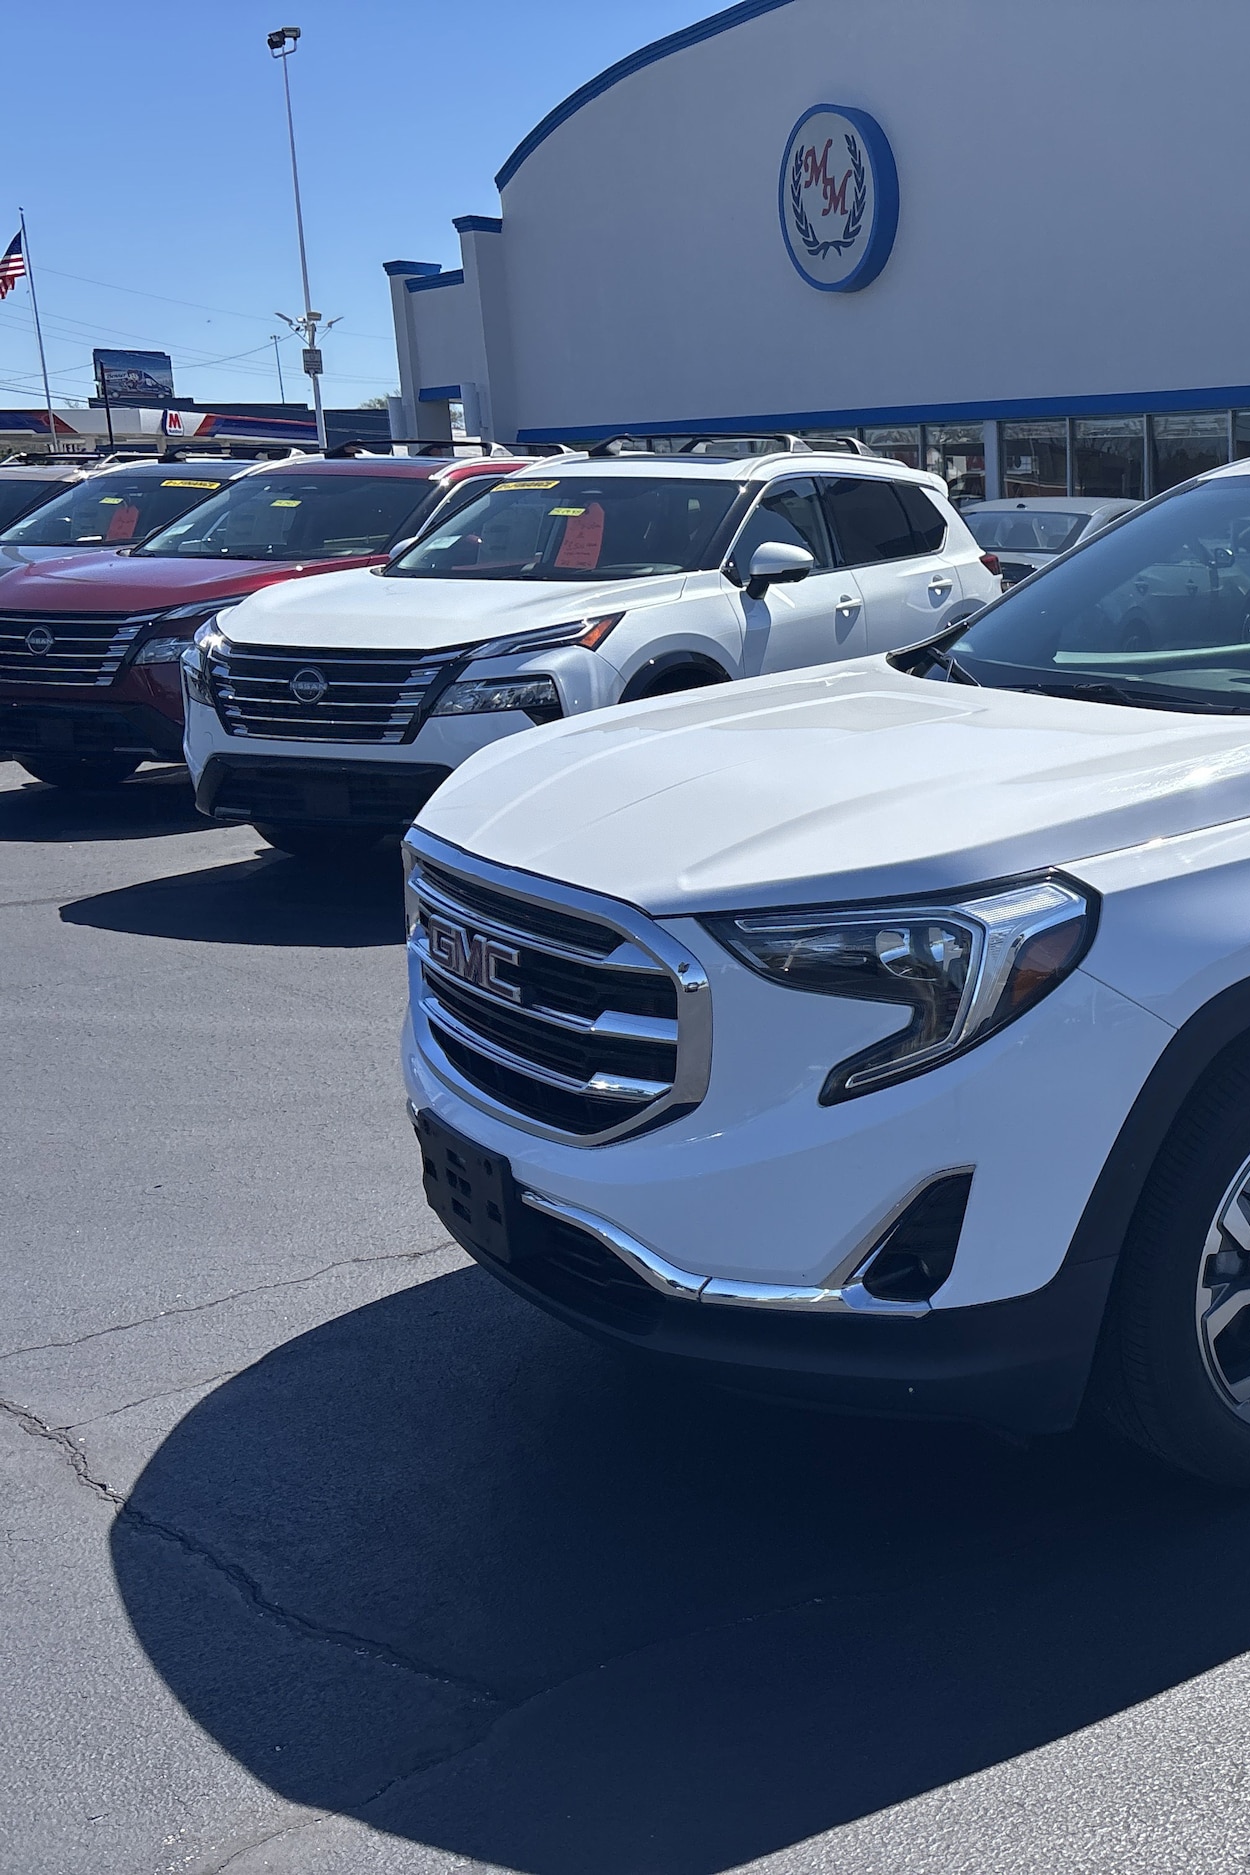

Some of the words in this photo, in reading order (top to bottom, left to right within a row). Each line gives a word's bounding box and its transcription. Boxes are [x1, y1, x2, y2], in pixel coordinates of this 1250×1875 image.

[168, 412, 181, 429] M
[290, 681, 328, 690] NISSAN
[429, 914, 521, 1003] GMC
